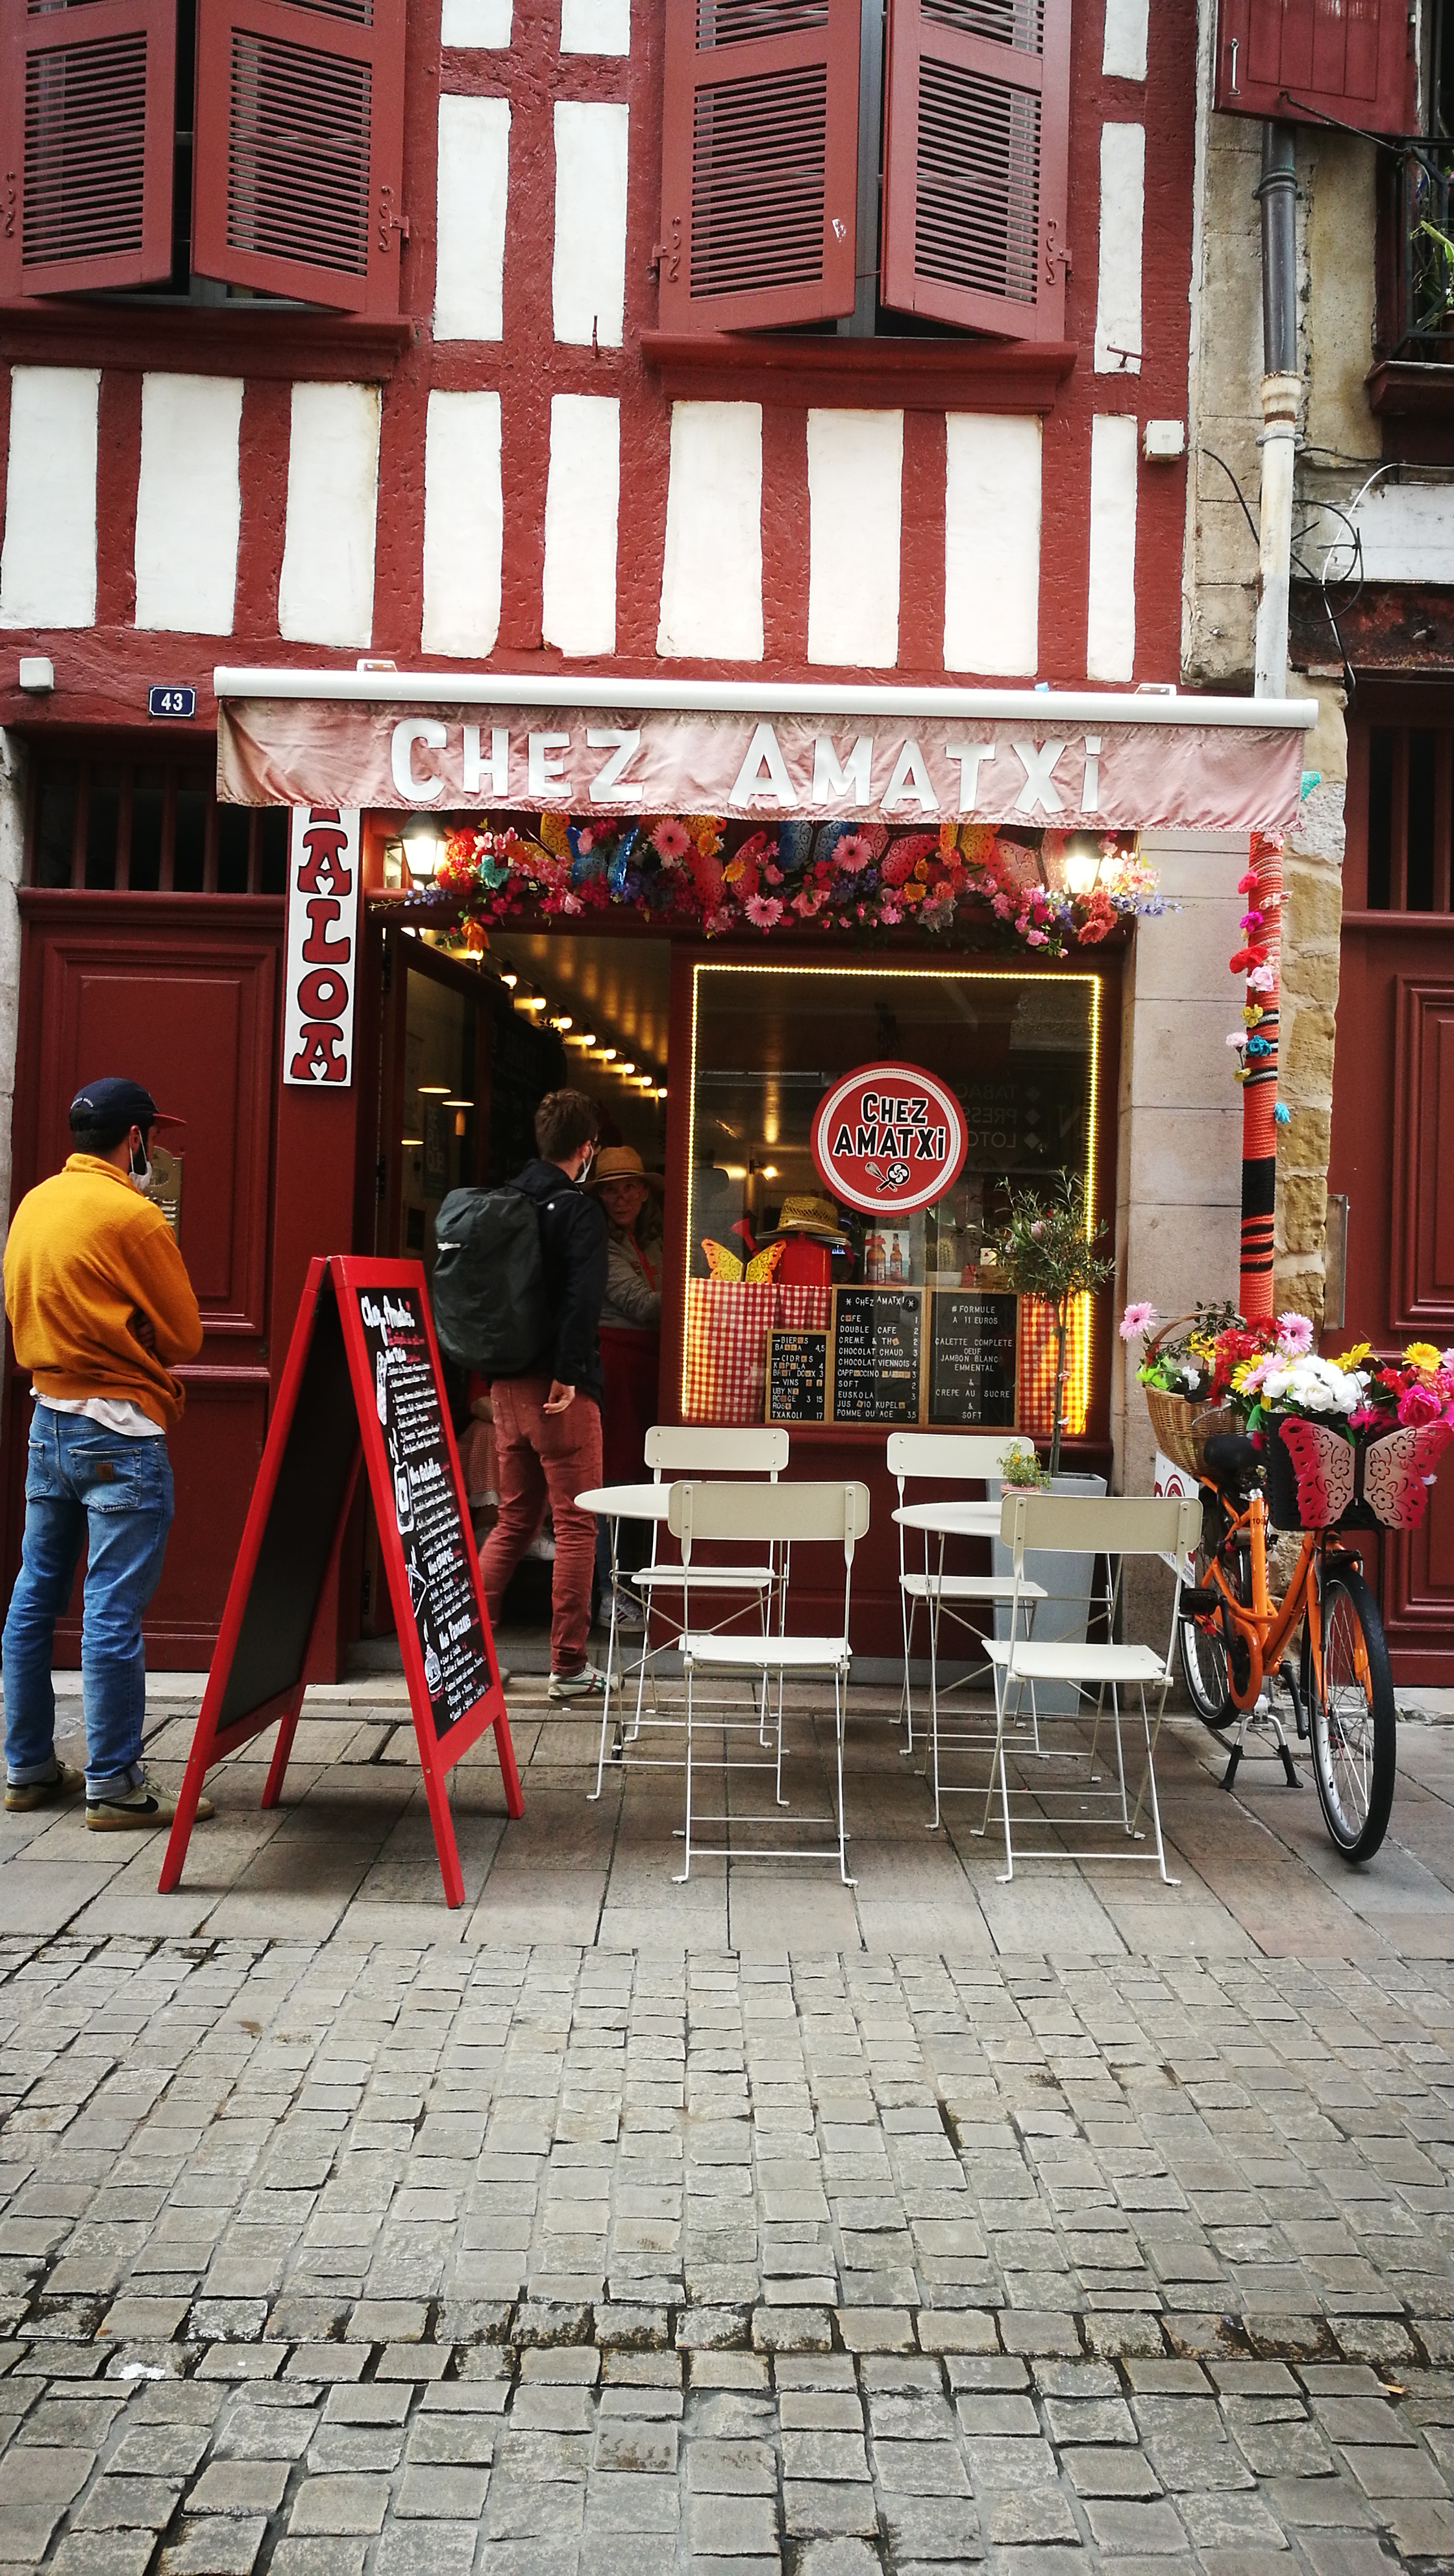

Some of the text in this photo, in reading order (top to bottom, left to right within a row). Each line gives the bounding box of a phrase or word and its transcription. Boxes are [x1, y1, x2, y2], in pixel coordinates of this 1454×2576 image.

[161, 693, 183, 711] 43
[391, 718, 643, 803] CHEZ
[290, 808, 352, 1082] ALOA
[861, 1092, 928, 1126] CHEZ
[855, 1296, 905, 1307] CHEZ AMATXI
[935, 1337, 1013, 1347] GALETTE COMPLETE
[815, 1344, 826, 1353] 4,5
[839, 1347, 876, 1356] CHOCOLAT
[772, 1411, 802, 1419] TXAKOLI
[837, 1409, 861, 1417] POMME
